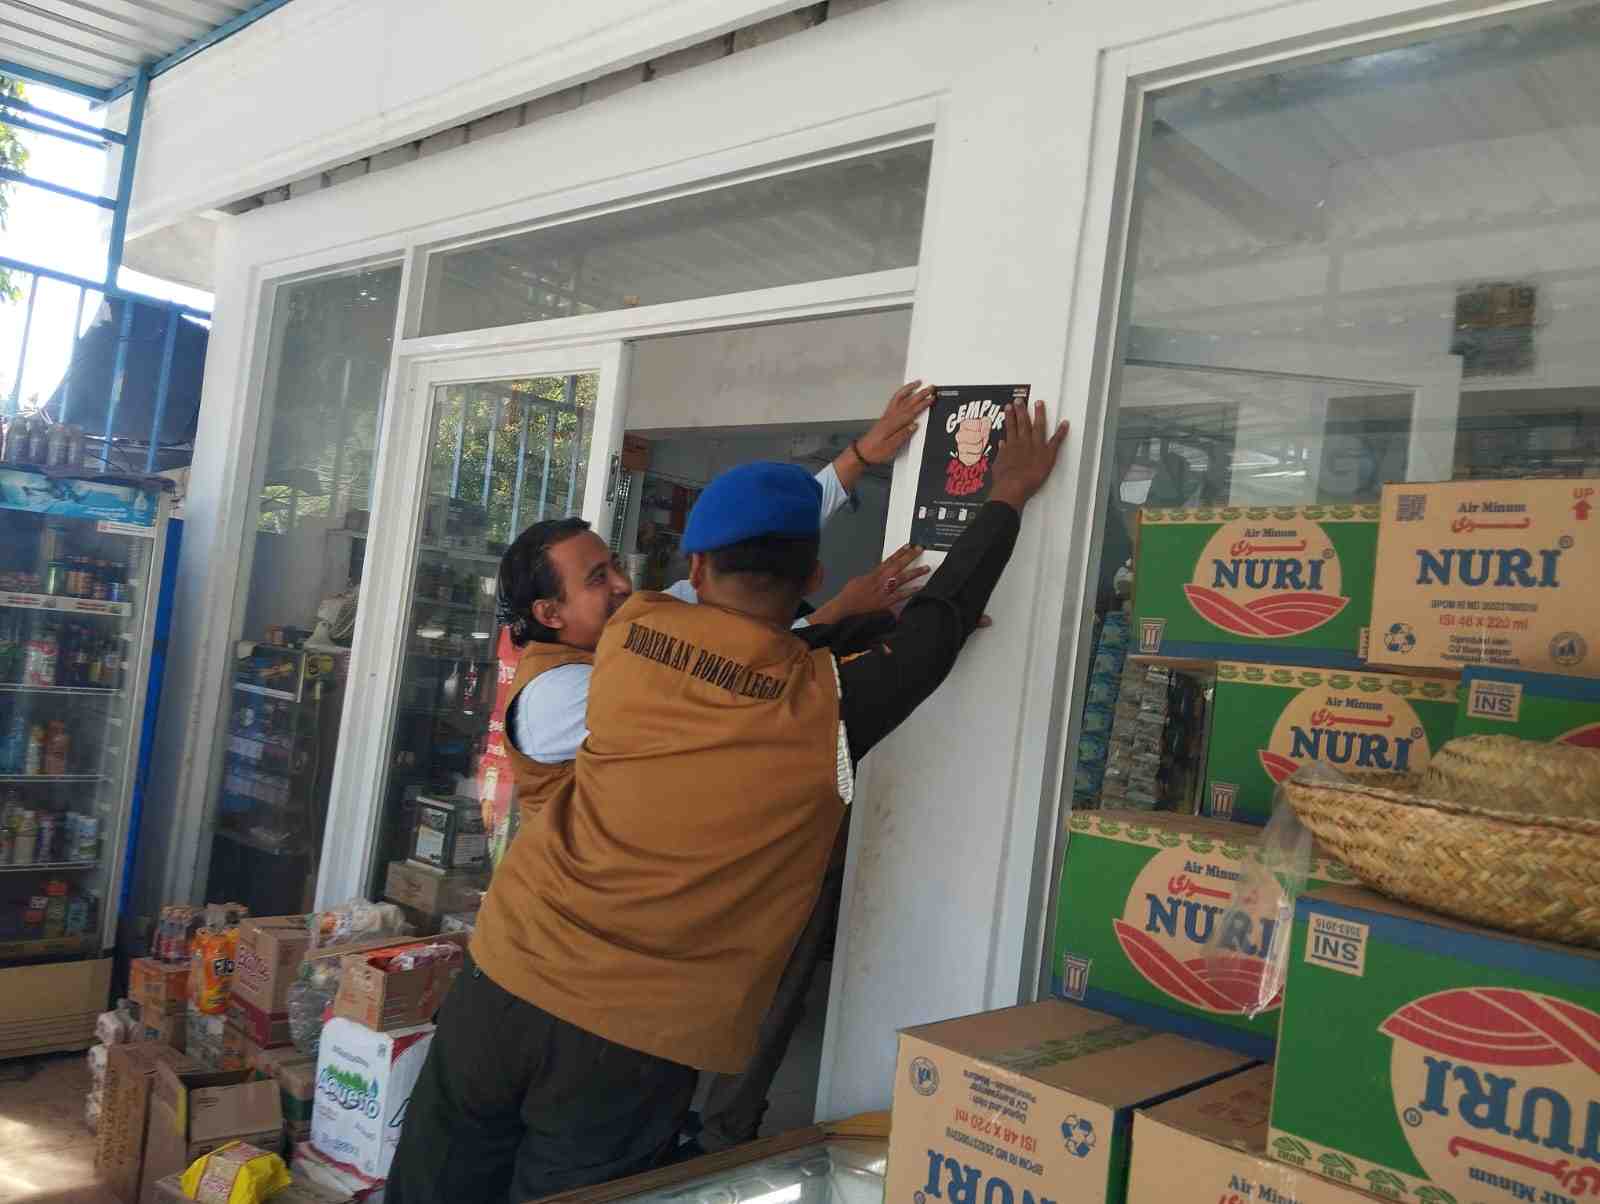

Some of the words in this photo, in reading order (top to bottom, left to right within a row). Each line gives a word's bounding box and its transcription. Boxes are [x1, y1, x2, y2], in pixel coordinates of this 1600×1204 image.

[946, 400, 1006, 433] GEMPUR
[1572, 487, 1595, 499] UP
[1457, 502, 1480, 513] Air
[1482, 501, 1527, 513] Minum
[1243, 528, 1261, 538] Air
[1262, 528, 1297, 538] Minum
[1211, 558, 1326, 591] NURI
[1415, 548, 1563, 588] NURI
[621, 622, 696, 672] BUDAYAKAN
[689, 649, 745, 692] ROKOK
[1326, 697, 1344, 707] Air
[1345, 698, 1384, 711] Minum
[1289, 725, 1414, 773] NURI
[1184, 860, 1203, 874] Air
[1144, 892, 1280, 959] NURI
[955, 1107, 969, 1121] ml
[969, 1114, 993, 1135] 220
[1004, 1130, 1020, 1146] 48
[1020, 1136, 1037, 1153] ISI
[1228, 1173, 1252, 1195] Air
